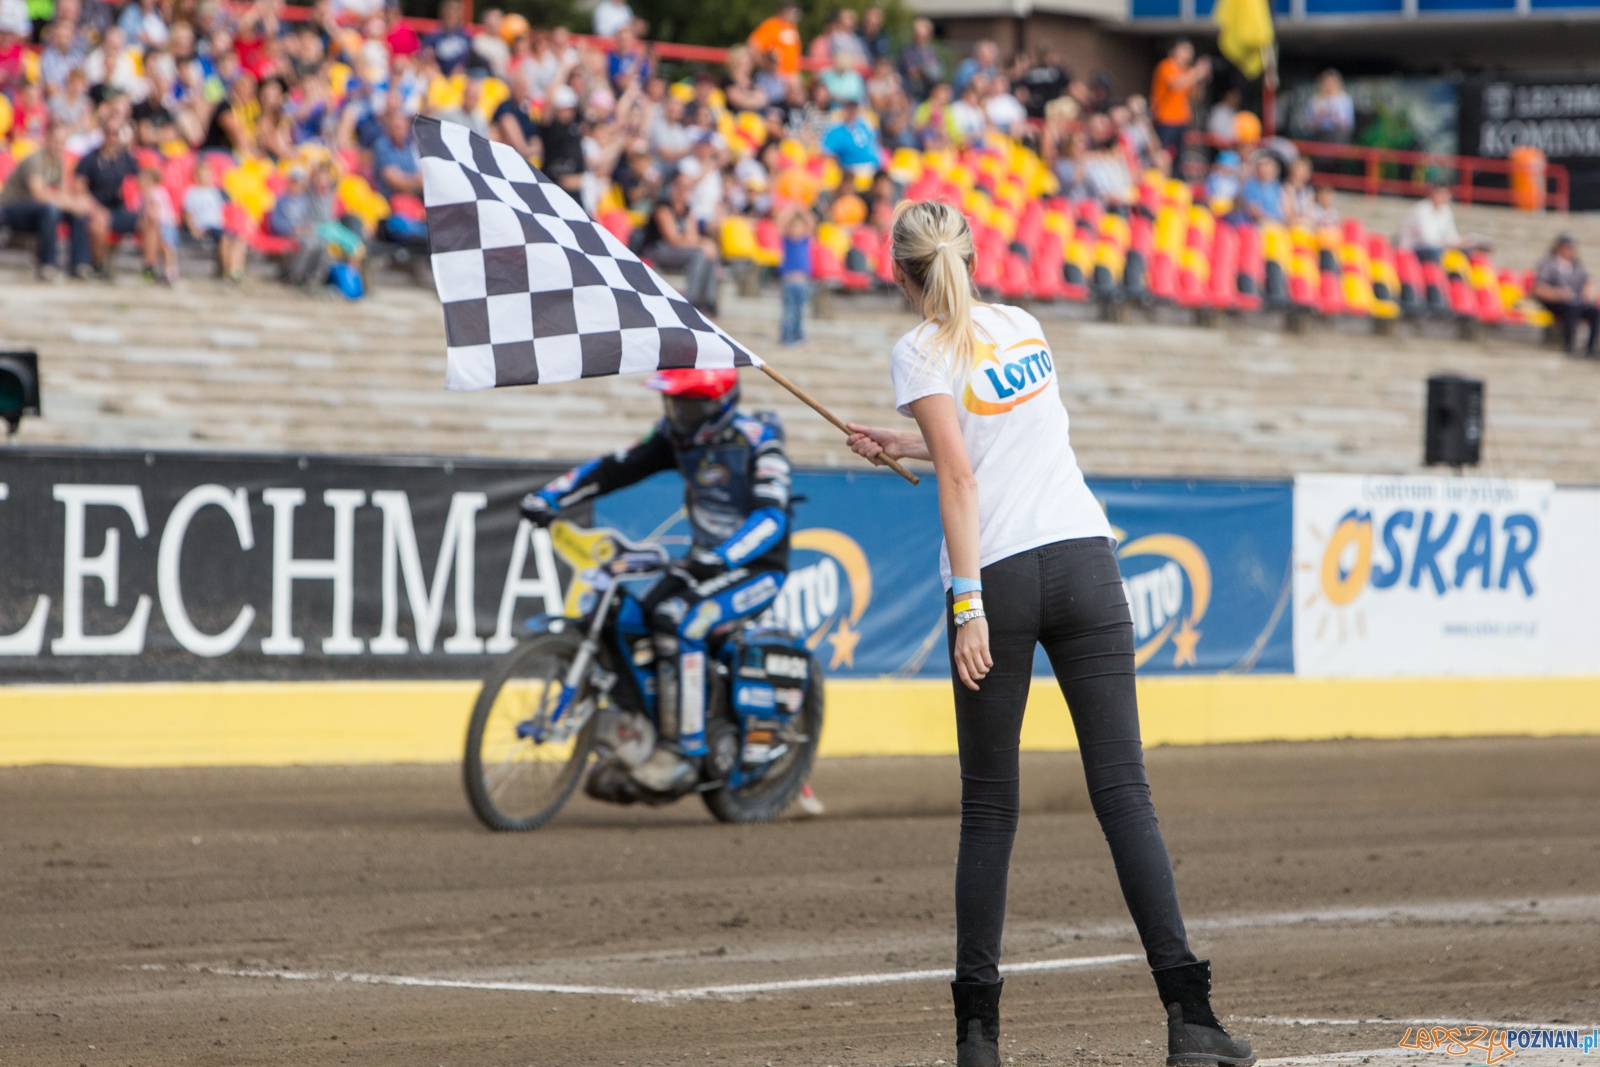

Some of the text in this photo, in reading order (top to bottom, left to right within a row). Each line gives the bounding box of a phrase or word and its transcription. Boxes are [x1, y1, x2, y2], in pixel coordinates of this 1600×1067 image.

[983, 350, 1053, 399] LOTTO
[1321, 507, 1540, 606] OSKAR
[752, 557, 839, 637] TTO
[1122, 561, 1183, 640] TTO
